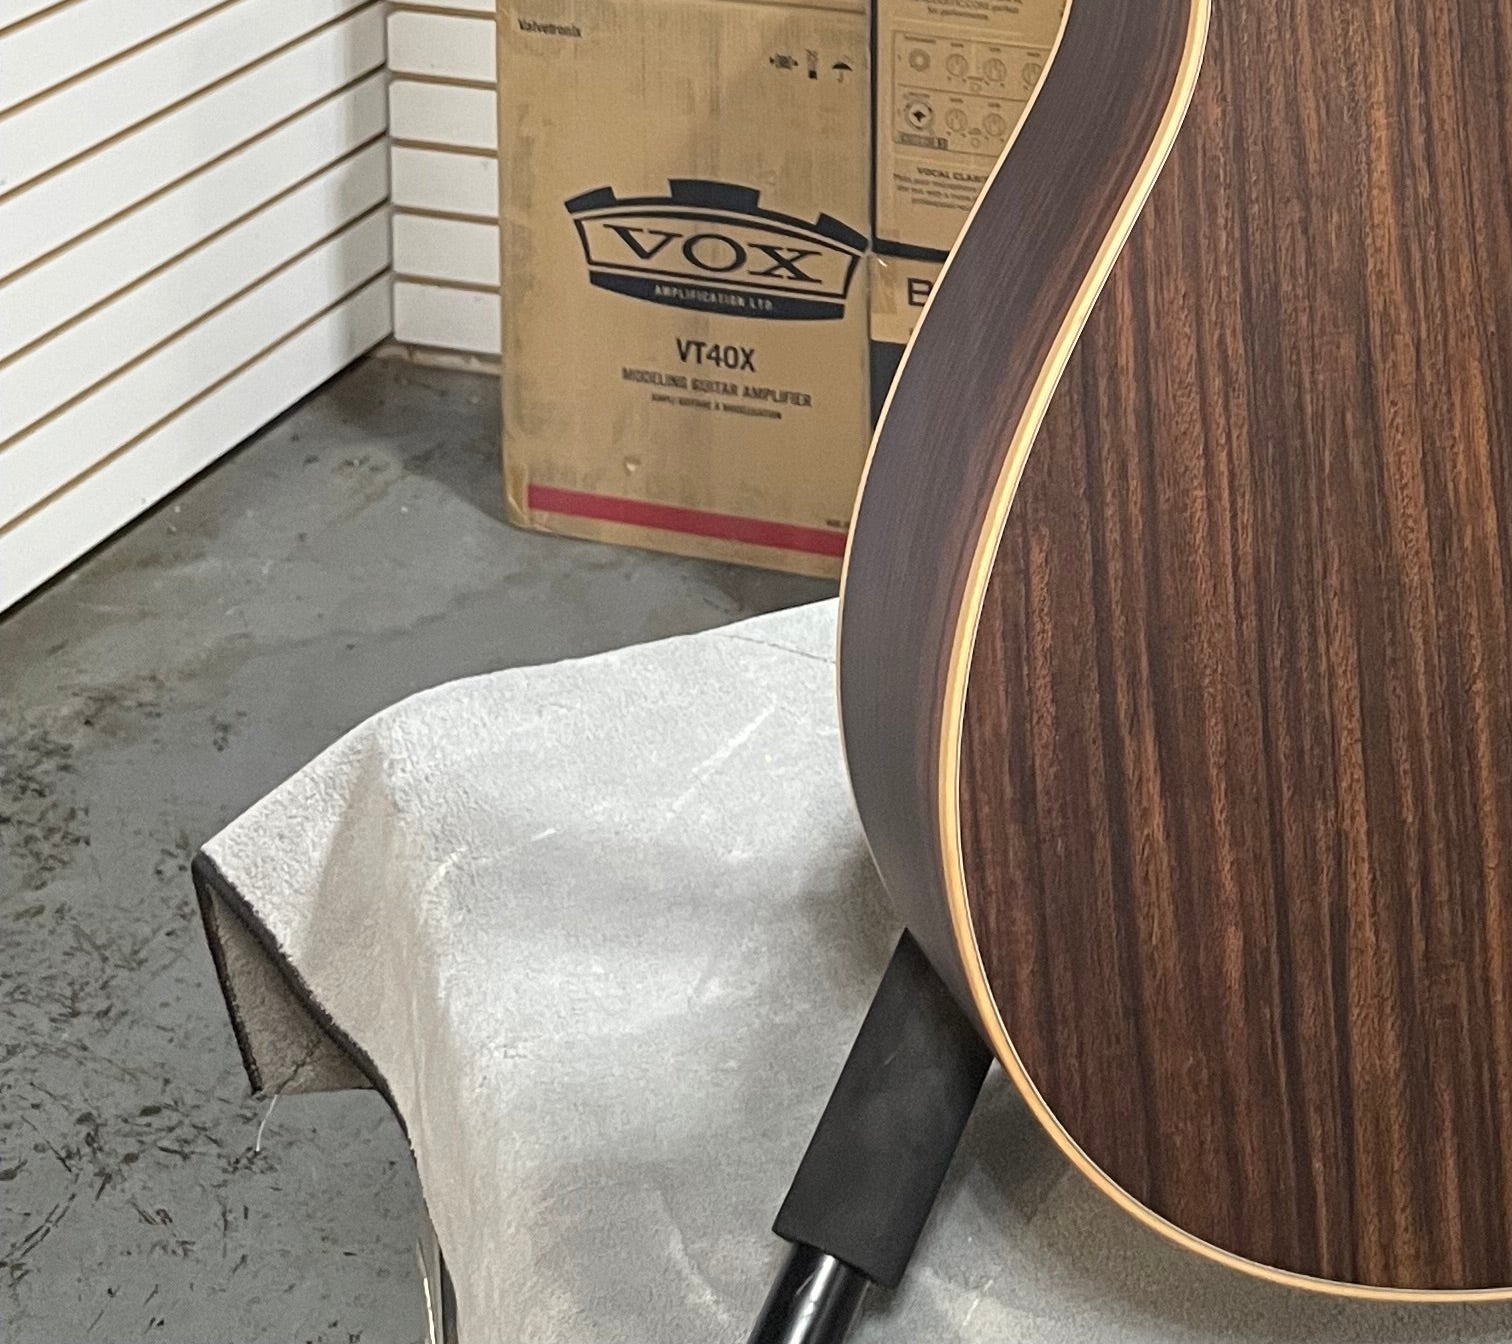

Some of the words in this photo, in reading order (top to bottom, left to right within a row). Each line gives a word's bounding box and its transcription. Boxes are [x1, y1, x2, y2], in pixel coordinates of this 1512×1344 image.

[602, 223, 823, 285] VOX
[676, 337, 756, 373] VT40X
[621, 366, 688, 390] MODELING
[691, 377, 739, 397] GUITAR
[742, 385, 813, 408] AMPLIFIER
